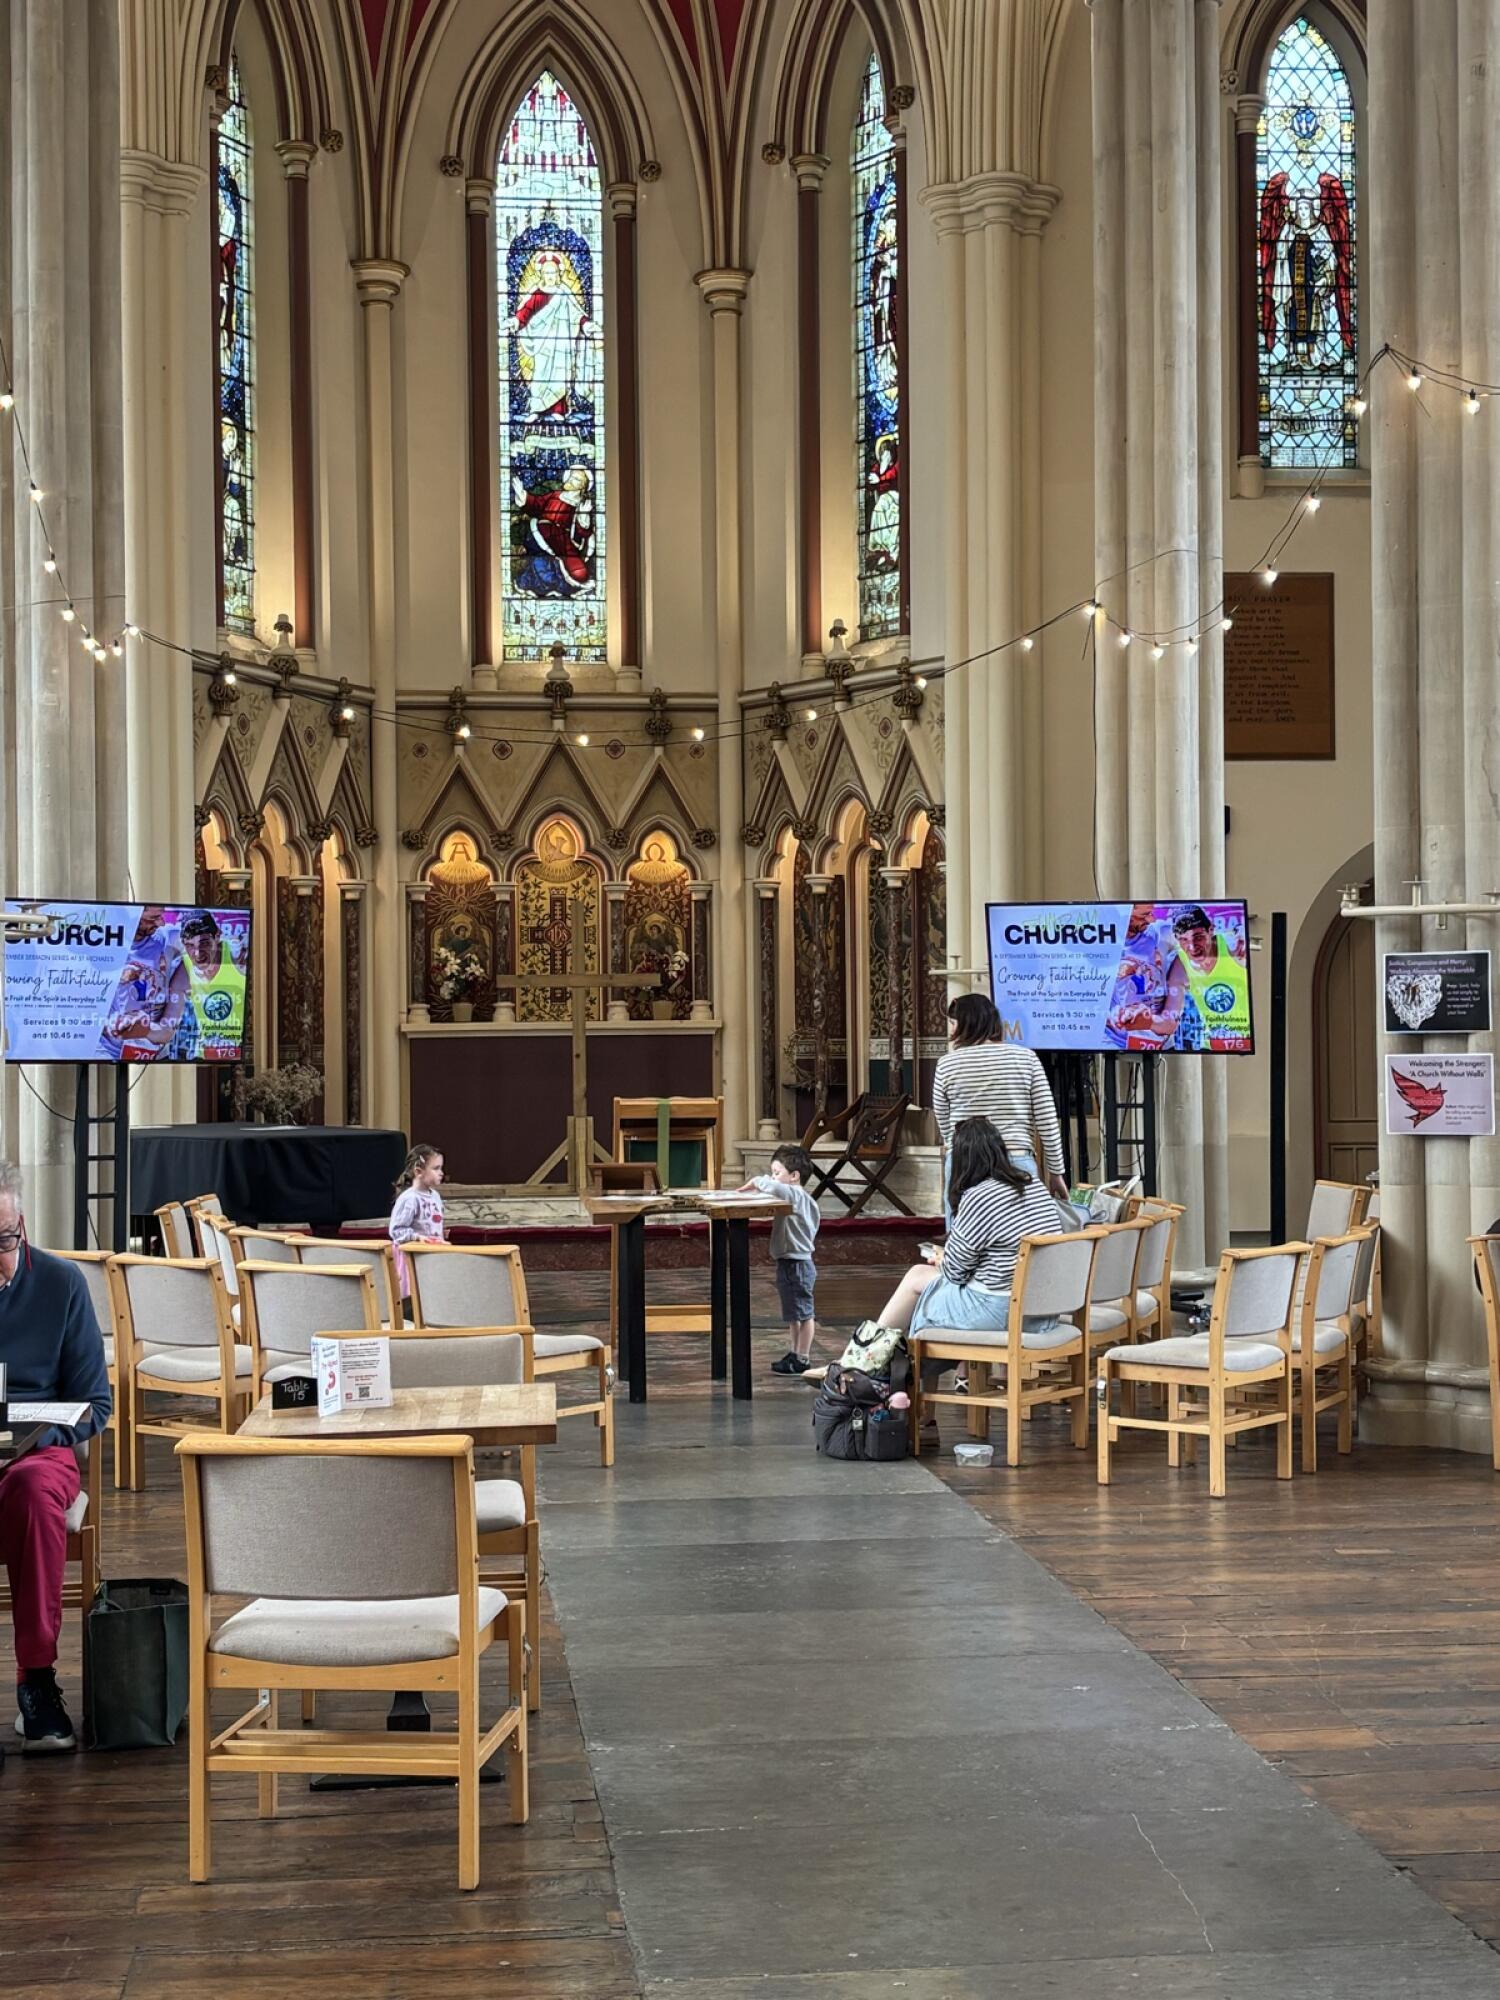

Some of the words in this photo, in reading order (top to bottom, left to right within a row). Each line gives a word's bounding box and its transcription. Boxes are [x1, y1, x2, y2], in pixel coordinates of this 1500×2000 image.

[1004, 924, 1117, 946] CHURCH
[48, 966, 112, 996] Faithfully
[998, 966, 1047, 991] Growing
[1050, 964, 1111, 991] Faithfully
[1032, 1011, 1065, 1019] Services
[24, 1018, 58, 1026] Services
[32, 1032, 48, 1040] and
[1408, 1059, 1443, 1069] Welcoming
[1417, 1070, 1440, 1078] Church
[1440, 1069, 1465, 1078] Without
[280, 1379, 310, 1393] Table
